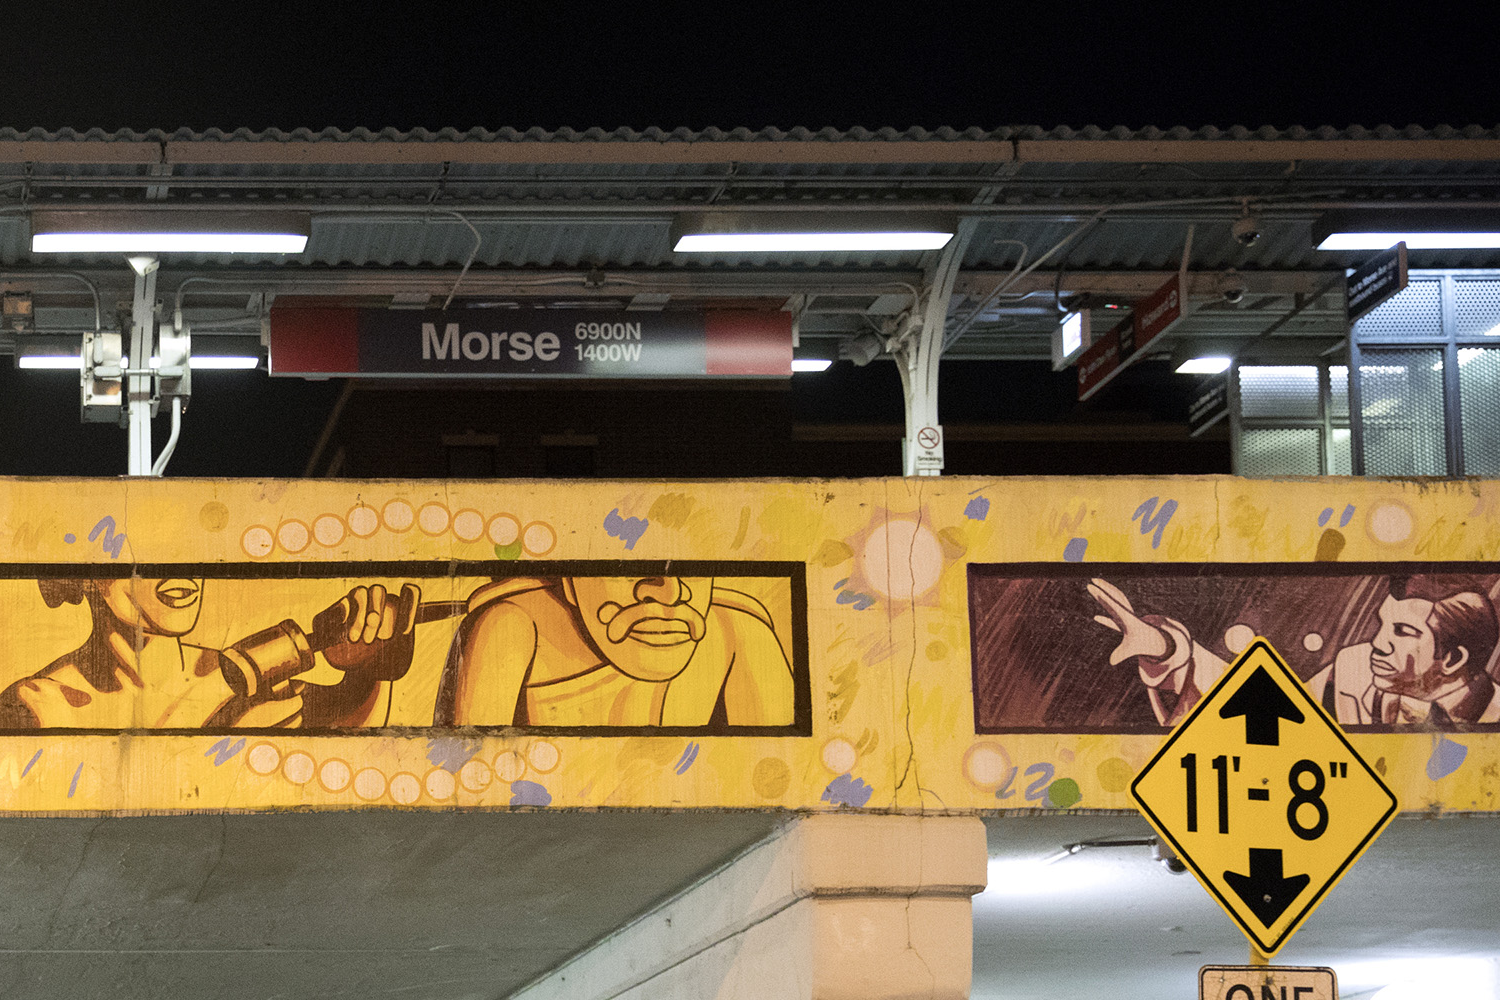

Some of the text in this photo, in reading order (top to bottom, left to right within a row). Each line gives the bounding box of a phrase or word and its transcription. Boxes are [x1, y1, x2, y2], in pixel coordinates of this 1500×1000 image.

[574, 321, 642, 341] 6900N
[421, 322, 561, 362] Morse
[573, 342, 643, 363] 1400W
